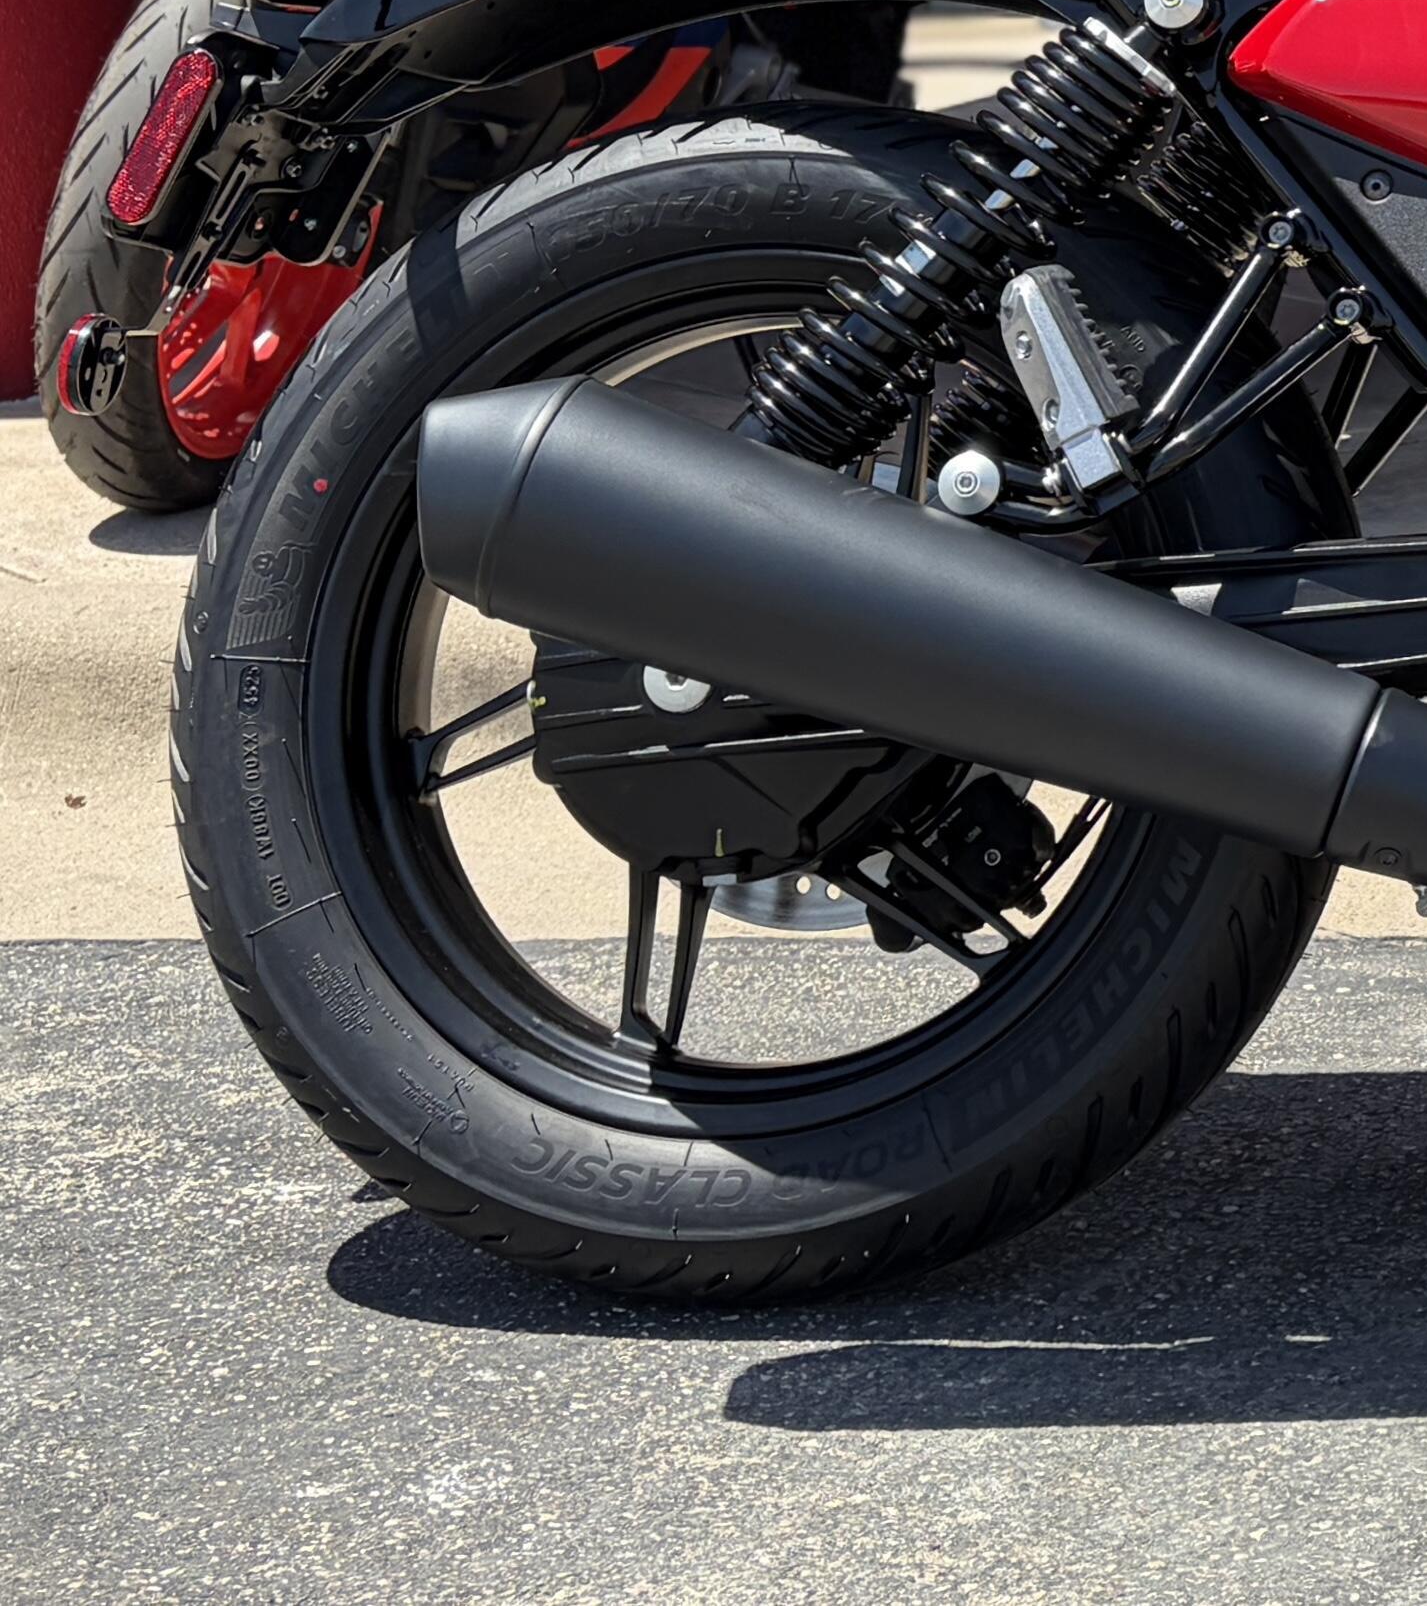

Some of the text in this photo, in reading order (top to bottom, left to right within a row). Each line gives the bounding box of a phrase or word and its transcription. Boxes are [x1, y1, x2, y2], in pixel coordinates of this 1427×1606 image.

[770, 183, 811, 216] B
[278, 249, 512, 532] MICHEL
[964, 837, 1203, 1129] MICHELIN
[511, 1138, 752, 1208] CLASSIC
